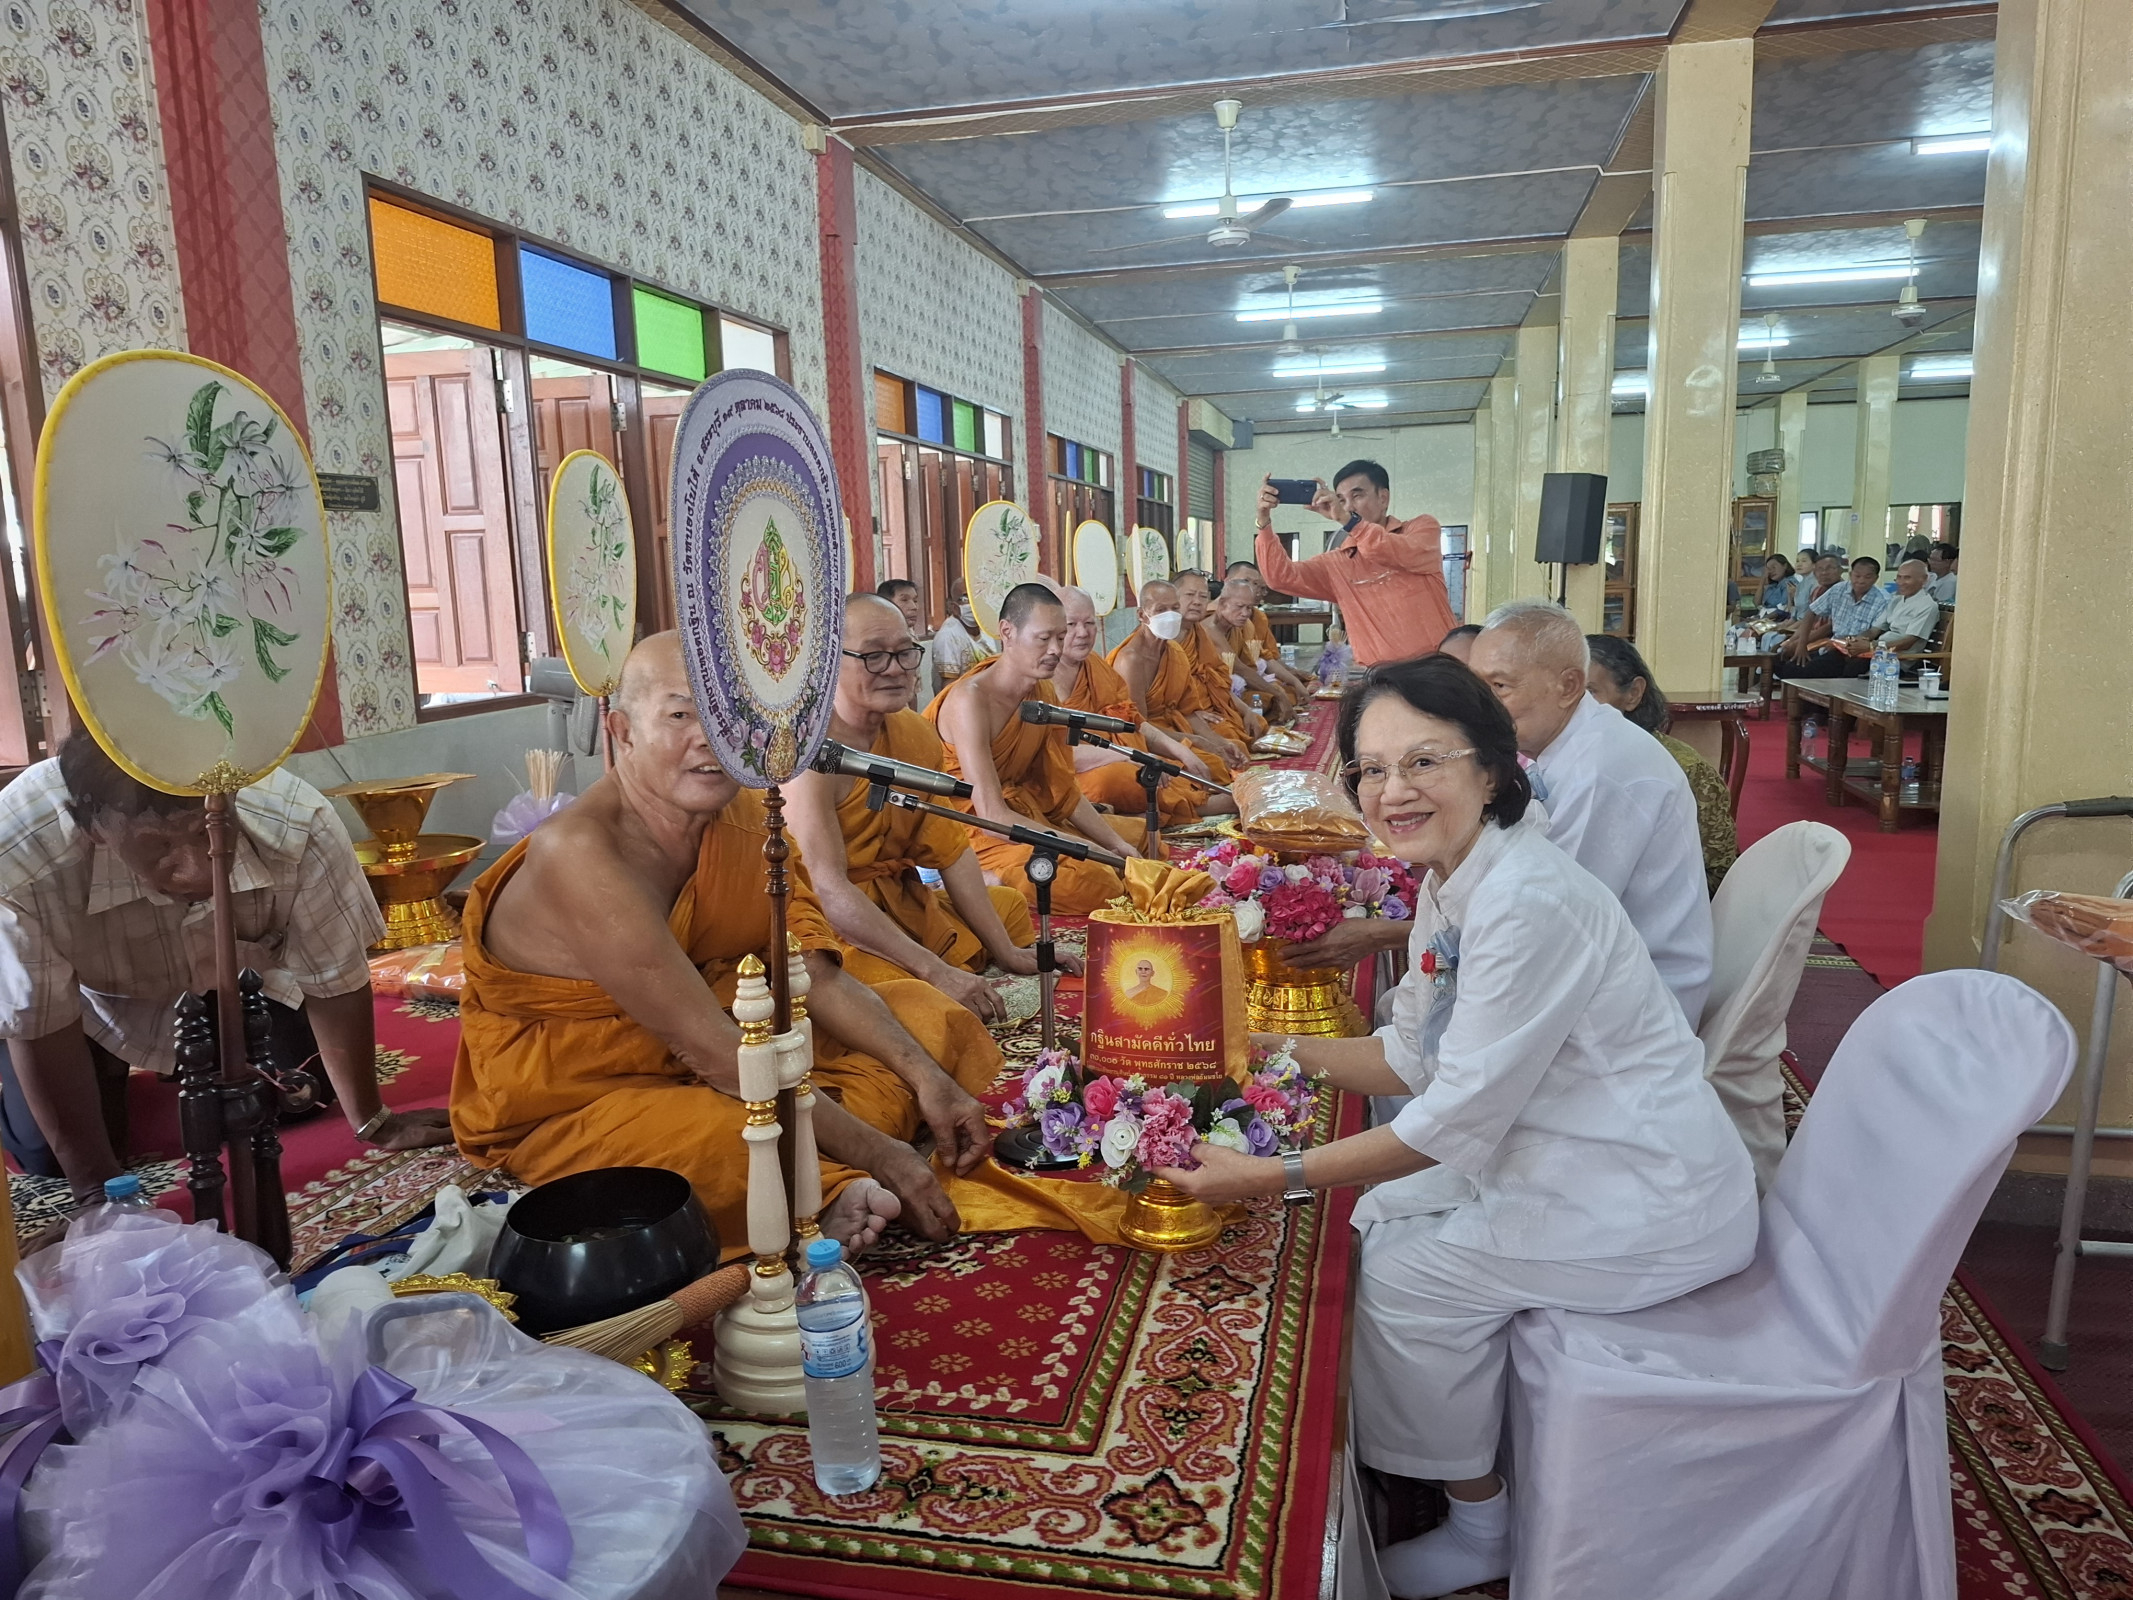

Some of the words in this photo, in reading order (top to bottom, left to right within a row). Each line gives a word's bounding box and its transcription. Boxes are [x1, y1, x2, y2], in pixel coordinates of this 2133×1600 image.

[687, 583, 694, 599] ณ
[734, 398, 762, 419] ตุลาคม
[1090, 1028, 1215, 1052] กฐินสามัคคีทั่วไทย
[1119, 1055, 1132, 1067] วัด
[1134, 1058, 1184, 1071] พุทธศักราช
[1186, 1060, 1217, 1070] ๒๕๖๘
